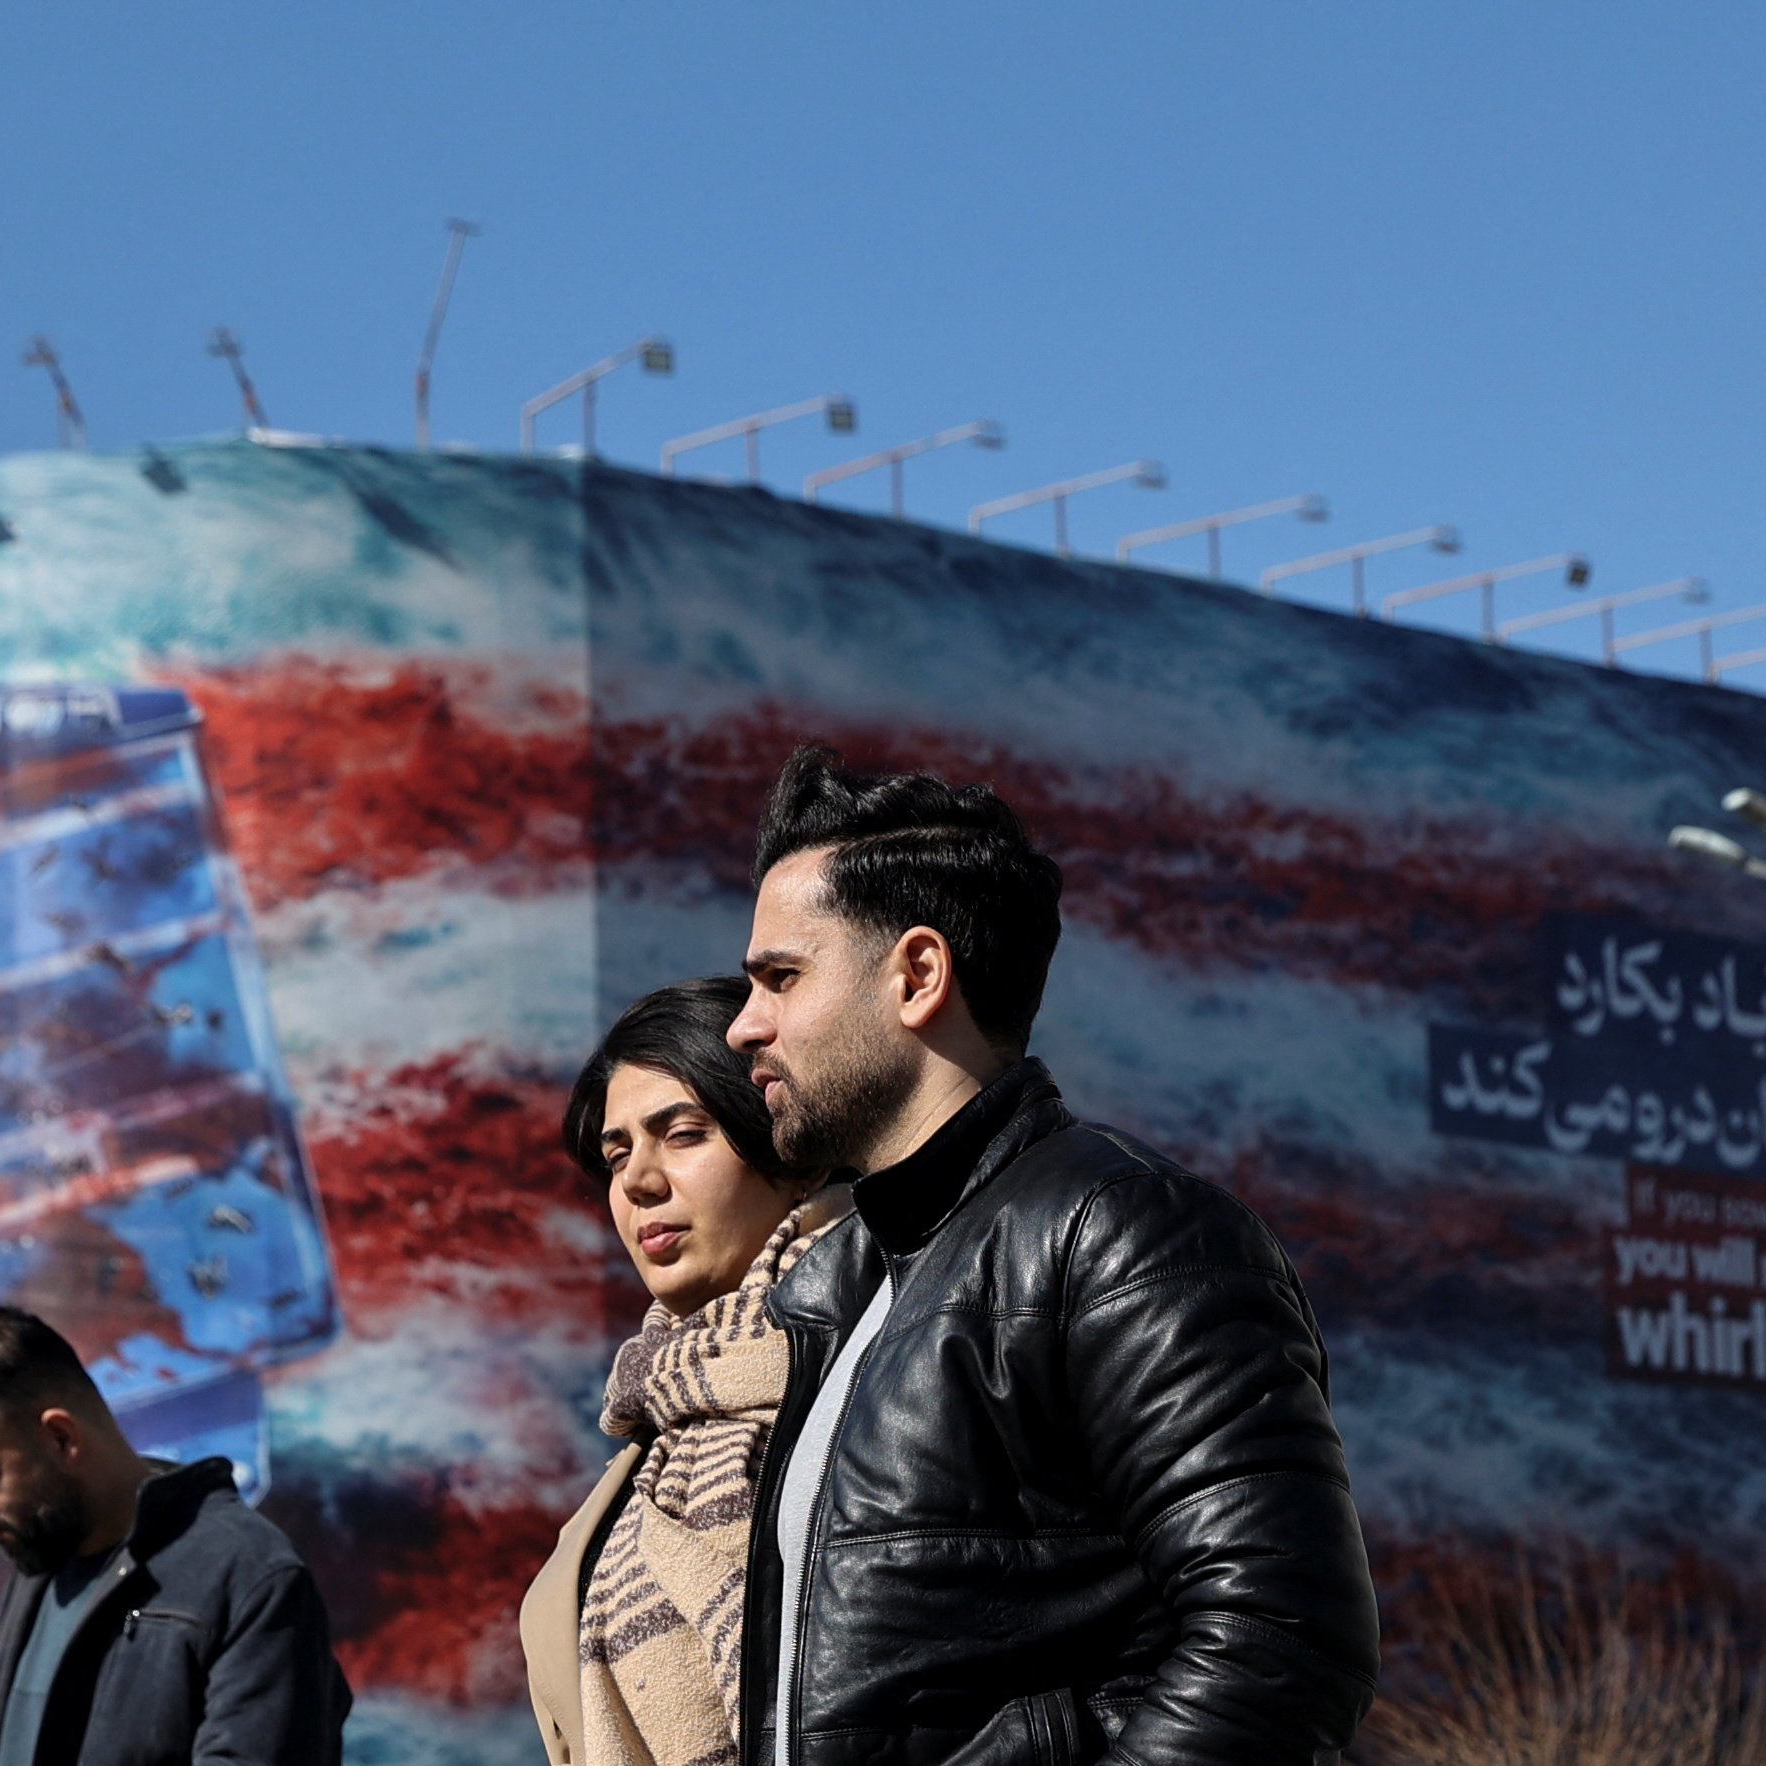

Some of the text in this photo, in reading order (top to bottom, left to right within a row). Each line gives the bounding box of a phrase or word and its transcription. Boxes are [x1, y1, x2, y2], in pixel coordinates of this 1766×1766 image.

[1556, 935, 1683, 1045] بکارد
[1664, 1189, 1717, 1231] you
[1612, 1236, 1687, 1288] you
[1691, 1238, 1755, 1289] will
